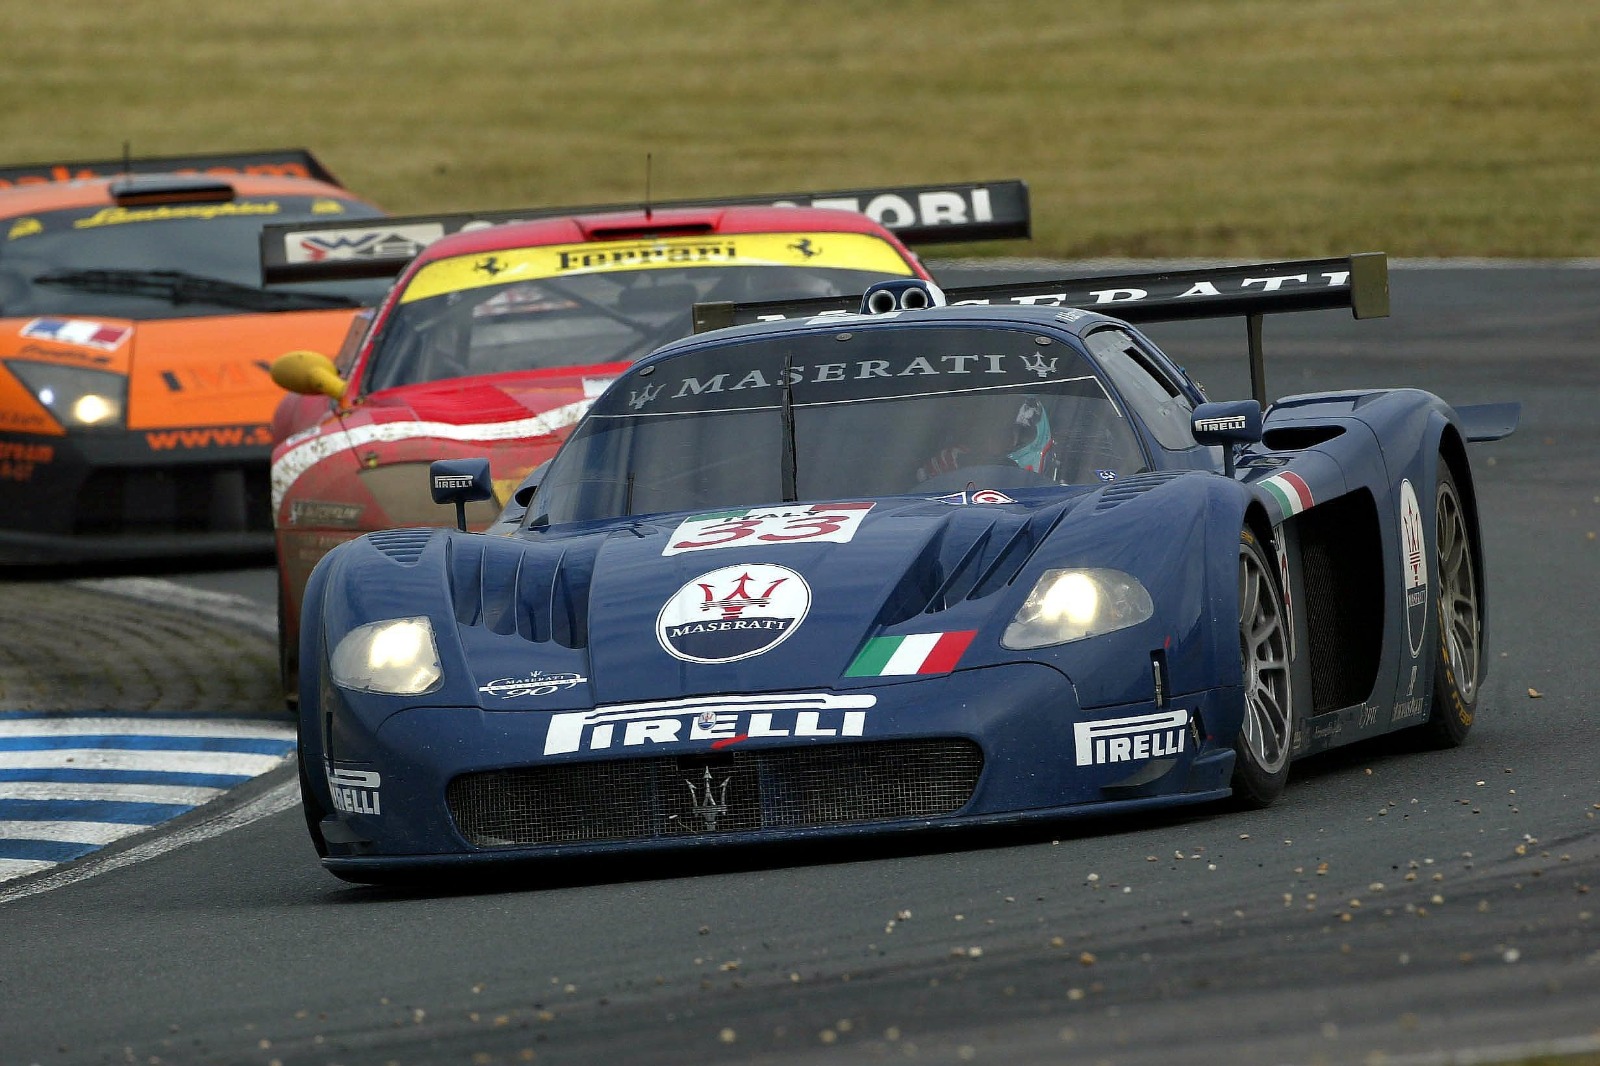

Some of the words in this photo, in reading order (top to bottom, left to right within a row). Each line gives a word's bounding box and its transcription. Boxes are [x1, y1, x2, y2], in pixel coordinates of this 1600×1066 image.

[556, 241, 736, 271] Ferrari
[671, 354, 1007, 399] MASERATI
[1194, 415, 1246, 432] PIRELLI
[146, 425, 274, 450] www.s
[434, 475, 474, 489] PIRELLI
[723, 510, 820, 523] ITALY
[673, 515, 850, 548] 33
[669, 620, 787, 638] MASERATI
[501, 685, 559, 700] 90
[544, 693, 877, 756] PIRELLI
[1073, 709, 1188, 767] PIRELLI
